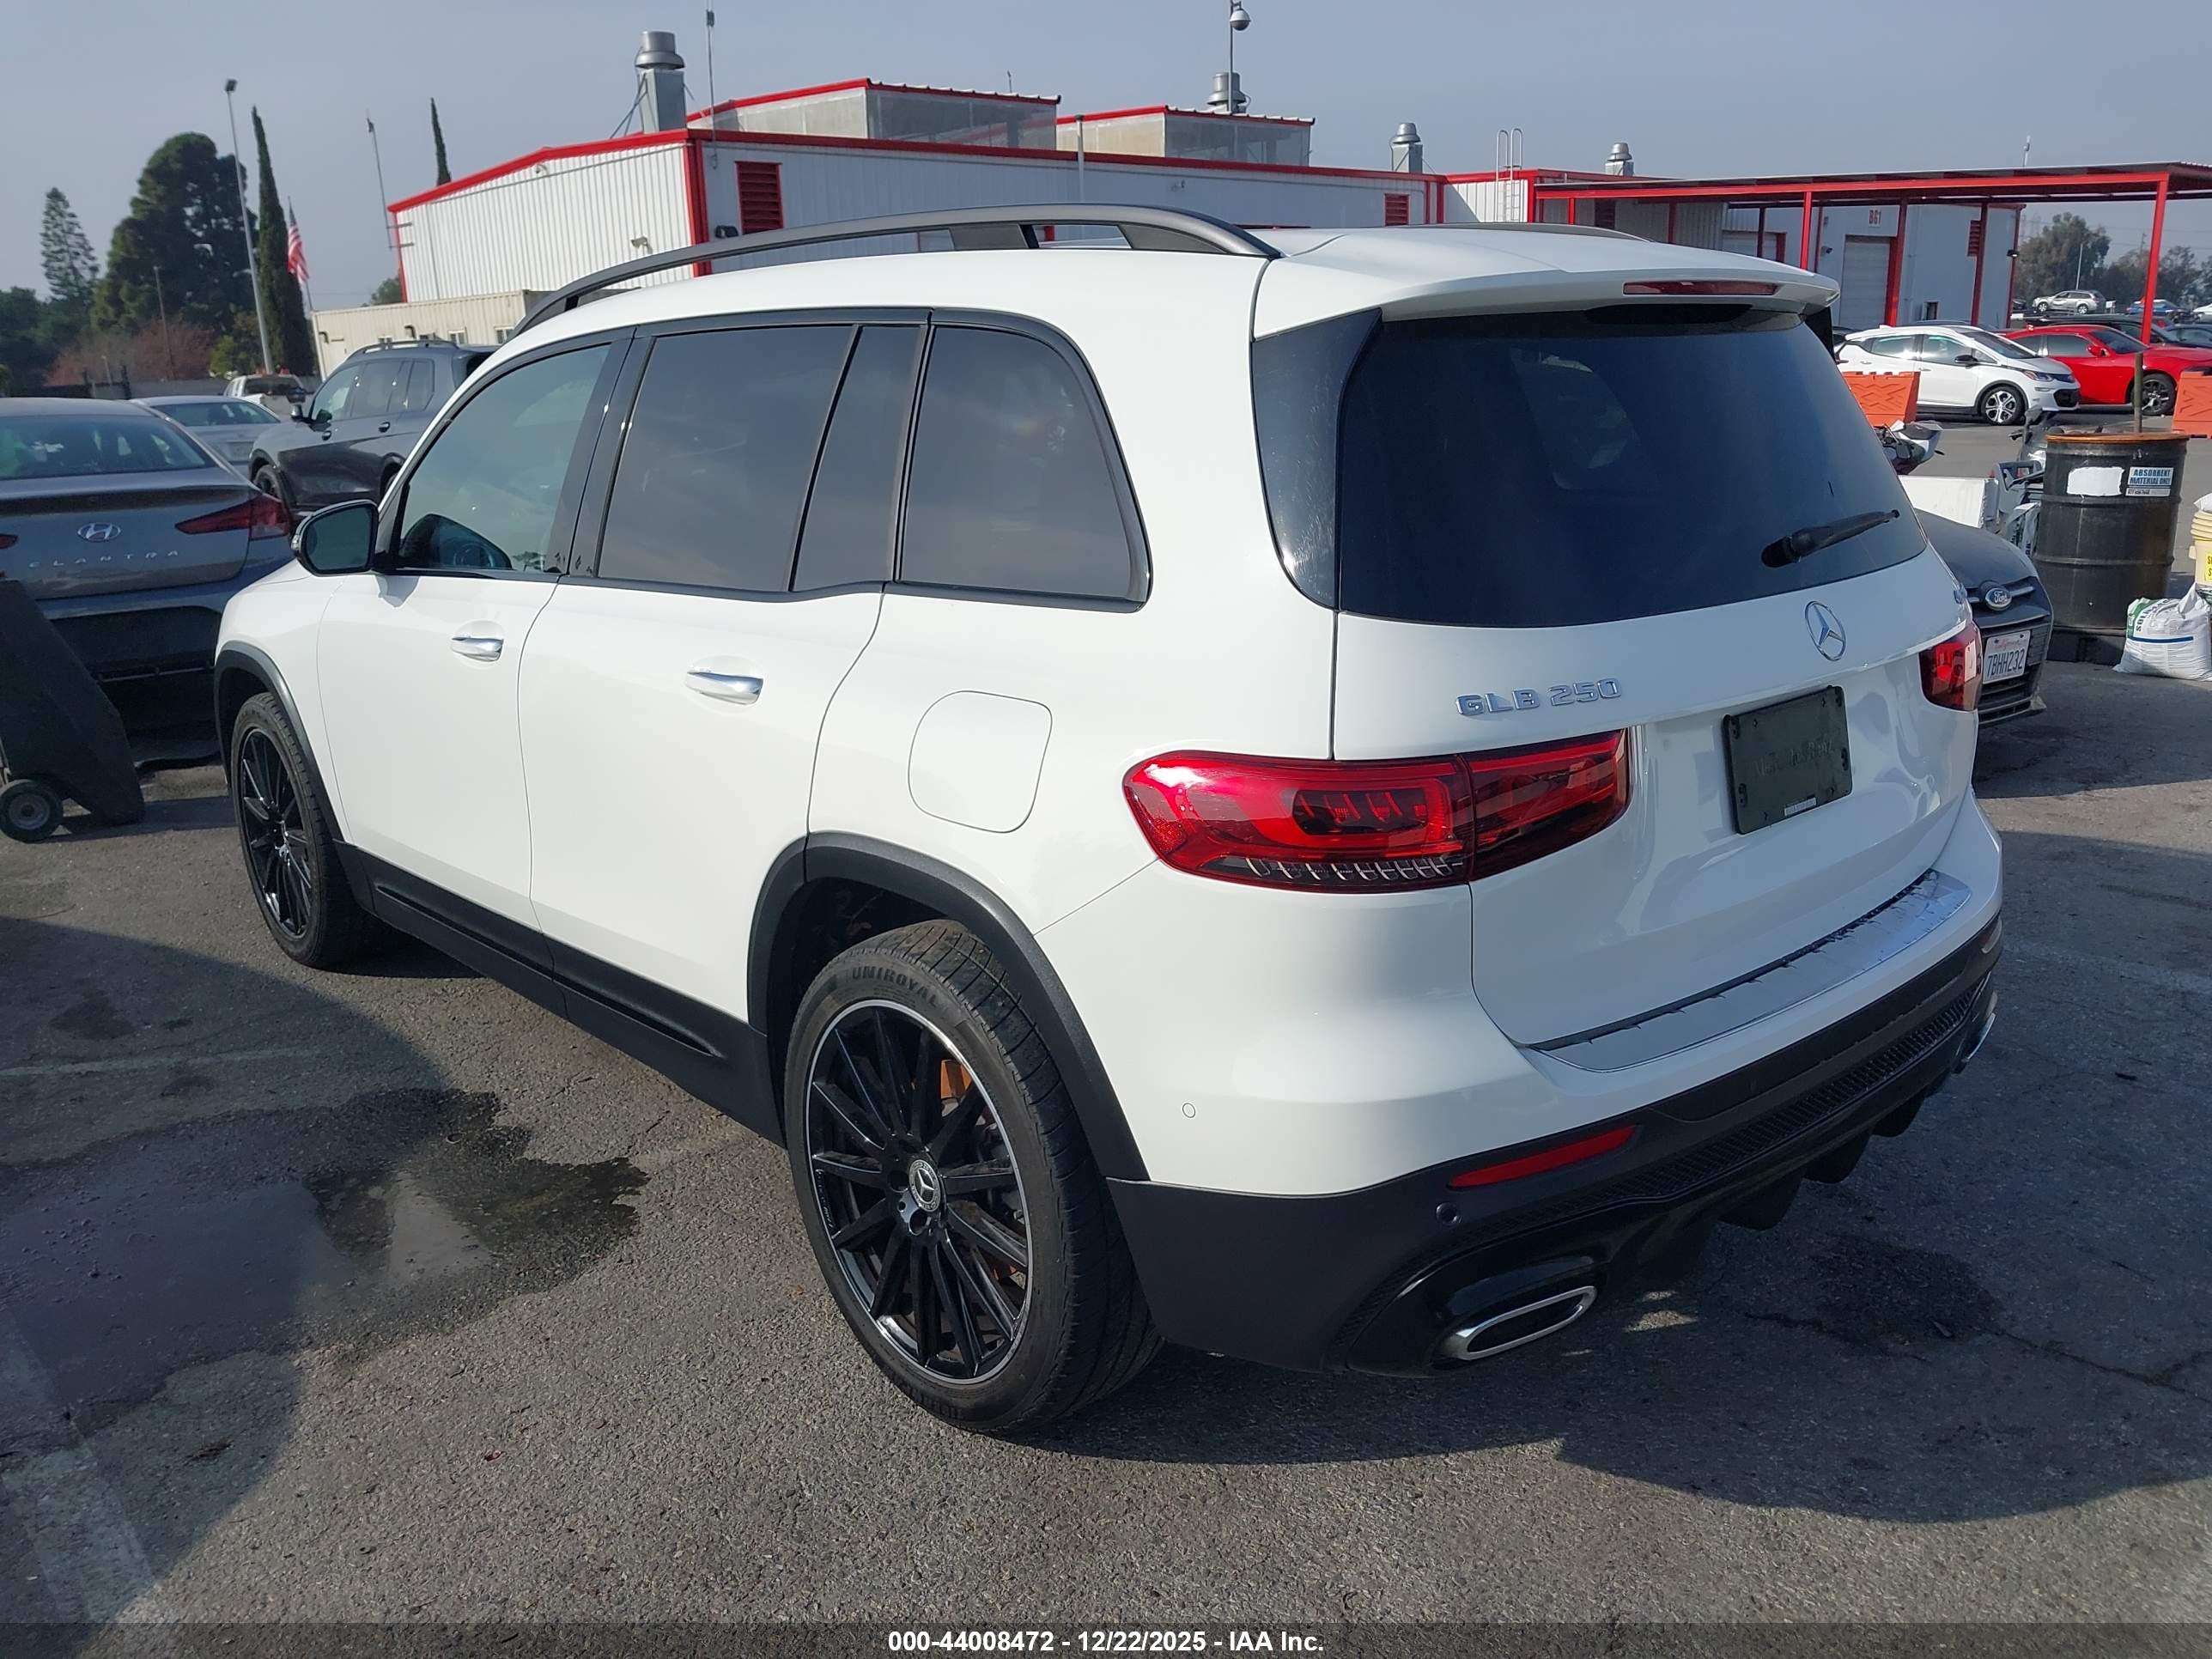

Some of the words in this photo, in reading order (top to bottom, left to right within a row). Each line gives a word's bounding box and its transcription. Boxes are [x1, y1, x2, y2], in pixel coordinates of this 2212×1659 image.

[2130, 477, 2158, 485] MATERIAL
[28, 550, 179, 568] ELANTRA
[1993, 590, 2008, 604] Ford
[1987, 648, 2025, 678] 7BHH232
[1455, 689, 1540, 716] GLB
[1547, 678, 1621, 707] 250
[852, 965, 937, 1009] UNIROYAL
